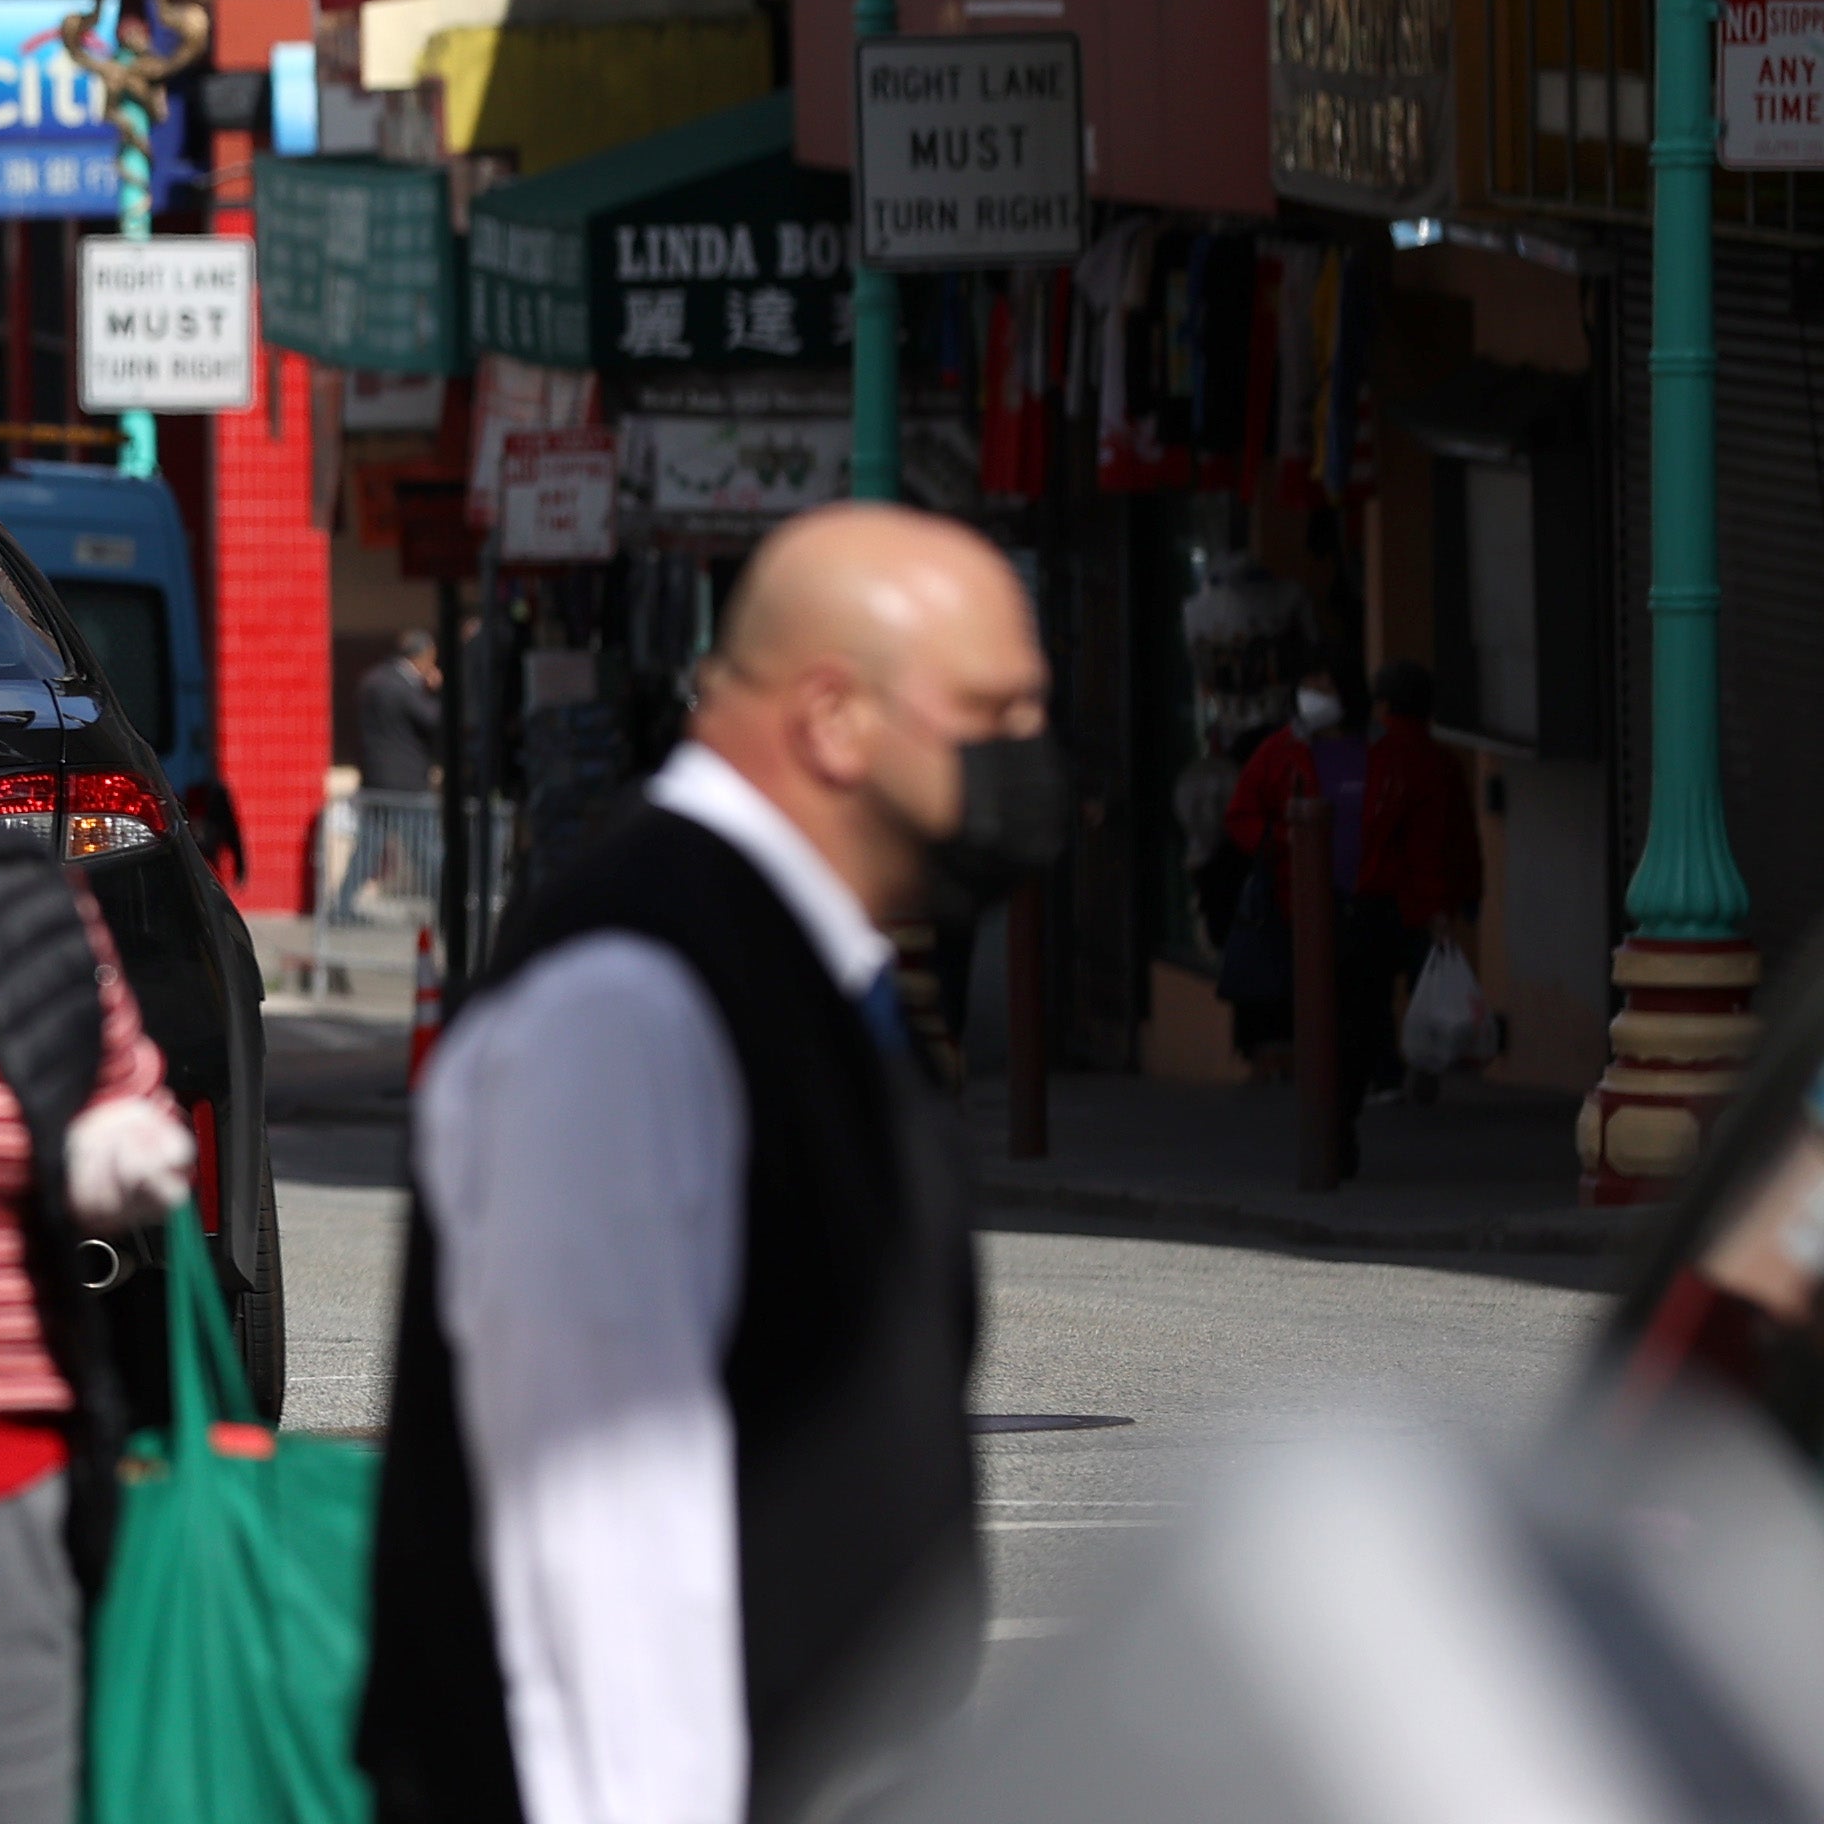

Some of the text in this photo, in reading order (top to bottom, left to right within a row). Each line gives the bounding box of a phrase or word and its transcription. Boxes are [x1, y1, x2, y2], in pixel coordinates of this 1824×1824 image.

[1727, 3, 1765, 42] NO
[870, 61, 1063, 102] RIGHT LANE
[1759, 57, 1815, 89] ANY
[1754, 94, 1821, 124] TIME
[909, 126, 1030, 172] MUST
[873, 194, 1074, 233] TURN RIGHT
[615, 221, 761, 283] LINDA
[776, 220, 852, 281] BO
[106, 309, 227, 340] MUST
